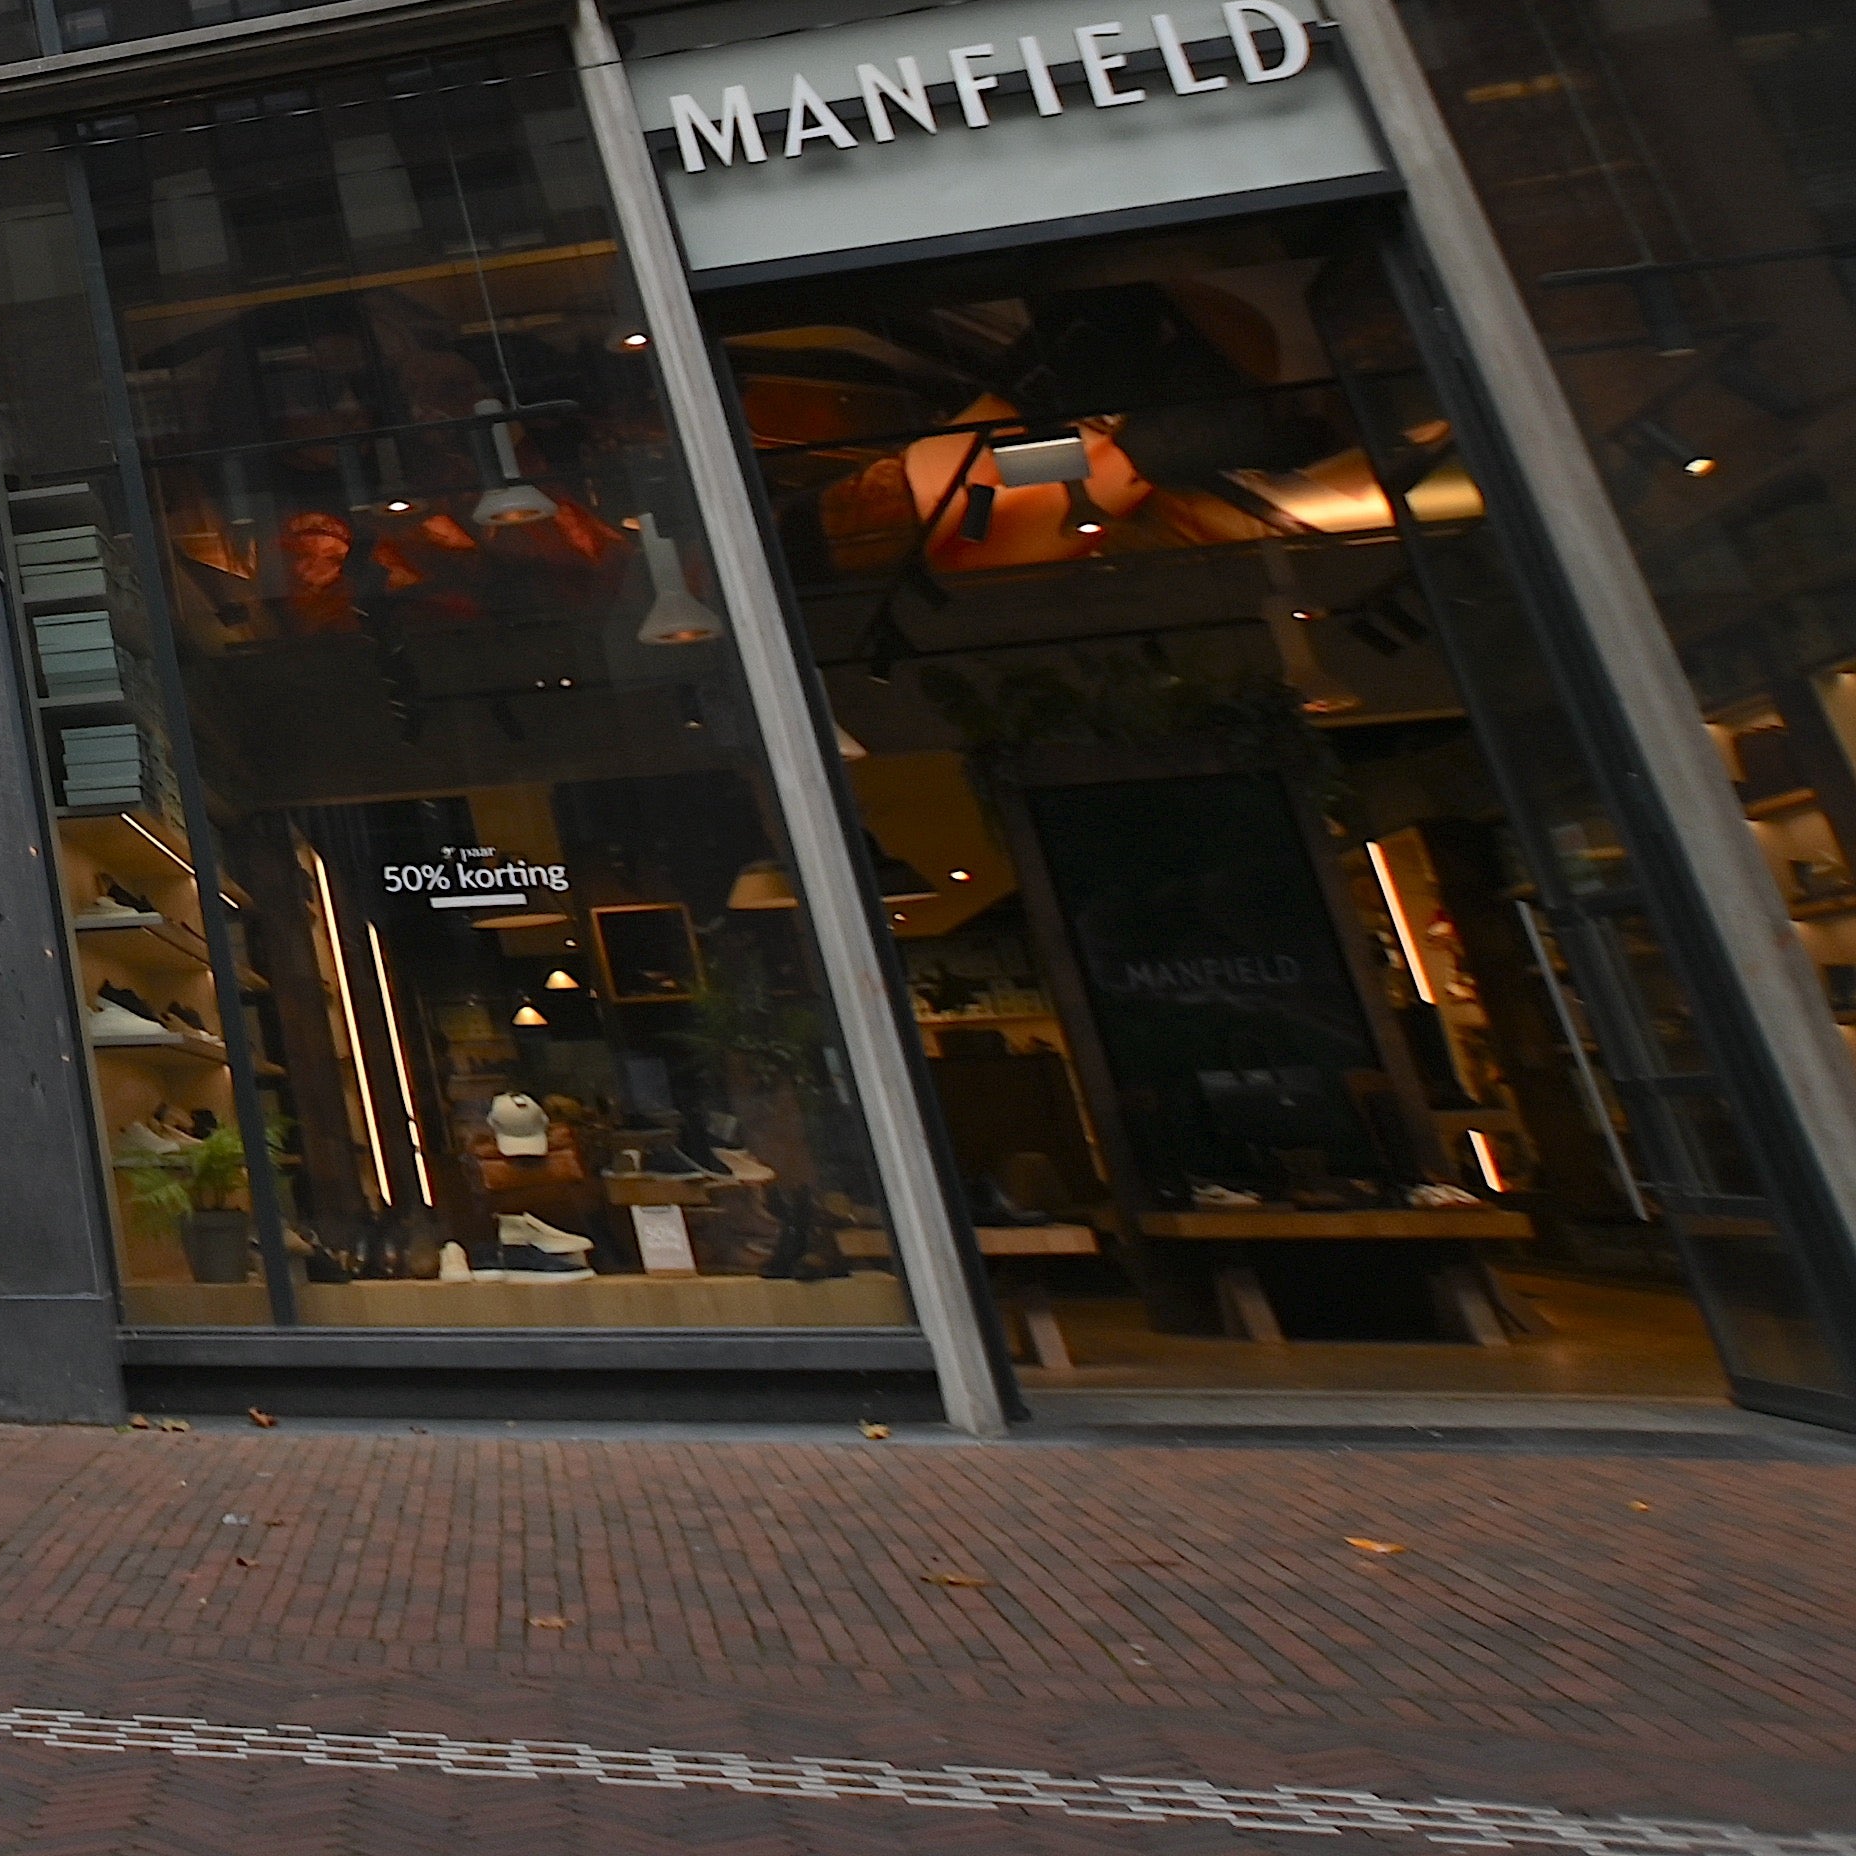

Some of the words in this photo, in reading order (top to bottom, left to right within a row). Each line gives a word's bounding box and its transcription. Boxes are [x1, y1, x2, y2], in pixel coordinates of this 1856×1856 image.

[459, 847, 496, 862] paar
[383, 864, 451, 892] 50%
[456, 860, 570, 892] korting
